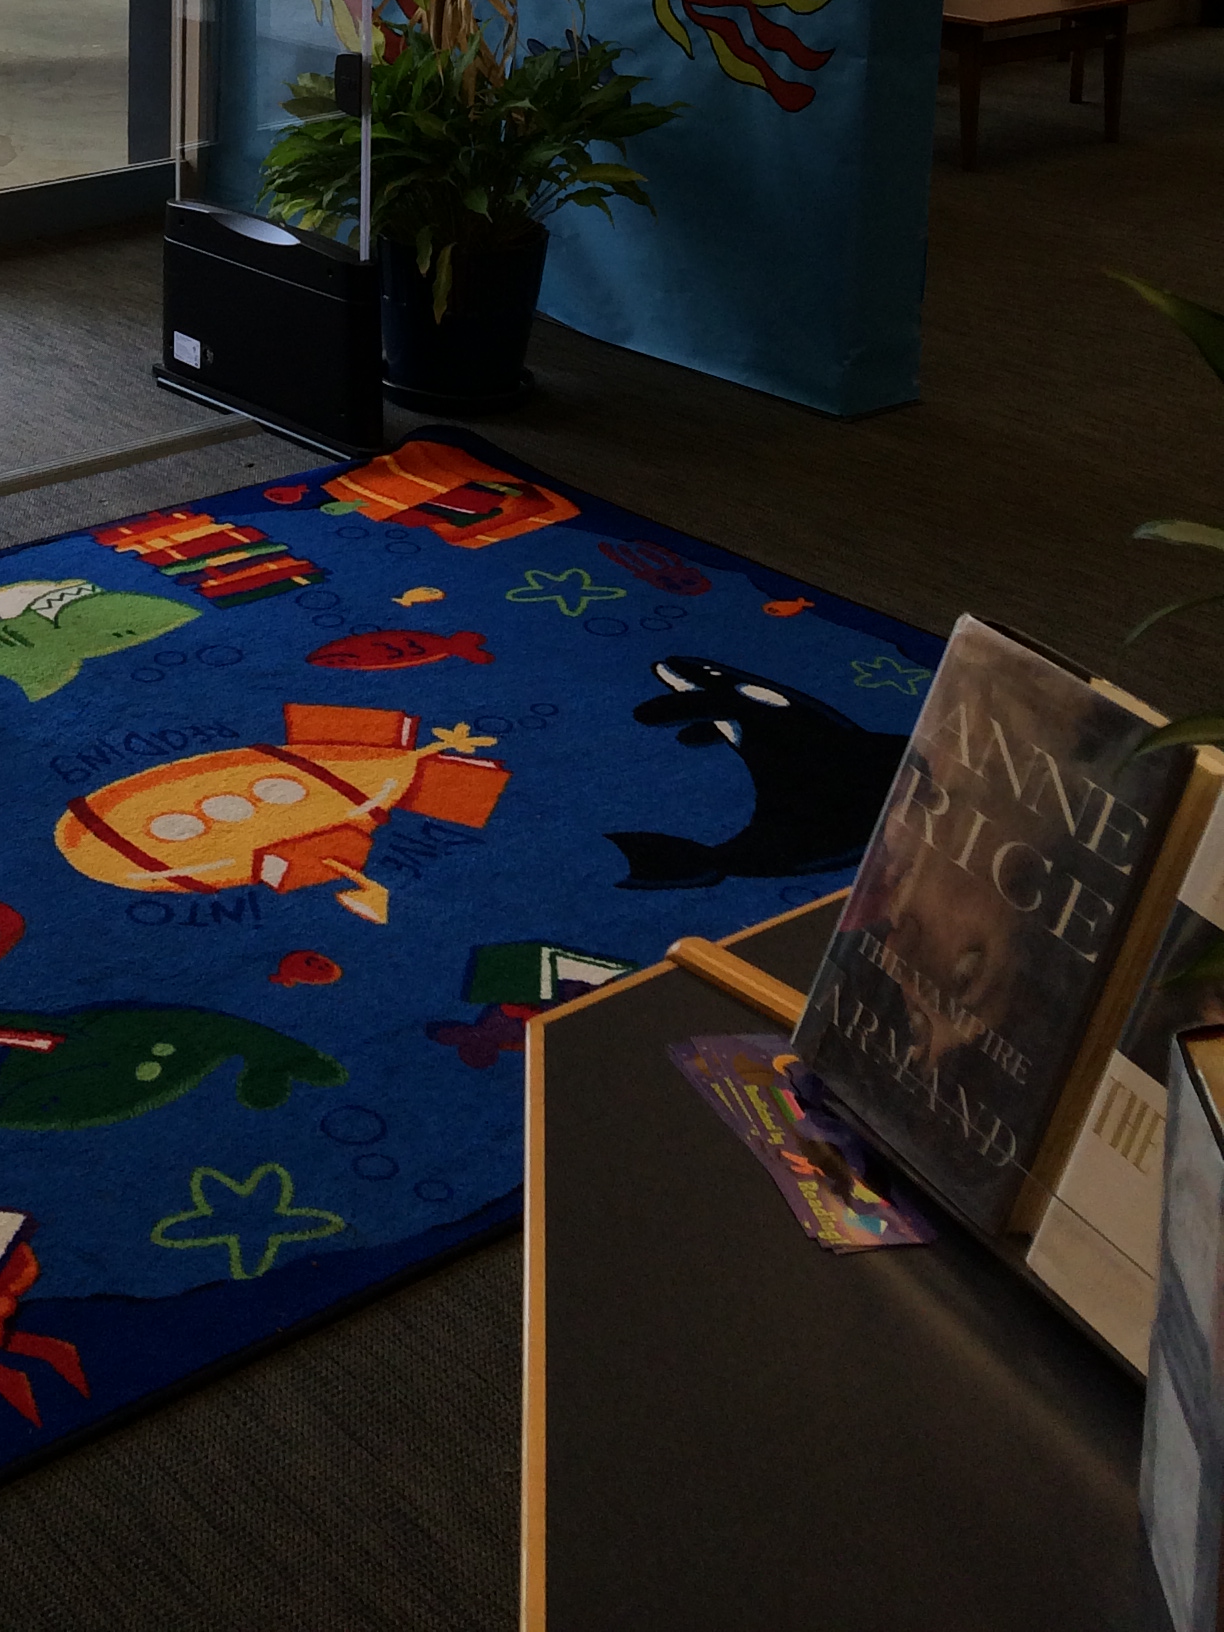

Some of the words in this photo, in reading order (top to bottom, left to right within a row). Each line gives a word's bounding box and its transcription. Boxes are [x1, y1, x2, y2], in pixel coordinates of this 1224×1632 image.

[895, 766, 1116, 965] RICE
[913, 702, 1149, 876] ANNE
[813, 982, 1018, 1167] ARMAND
[859, 928, 908, 985] THE
[910, 970, 1034, 1085] VAMPIRE
[1091, 1074, 1167, 1177] THE
